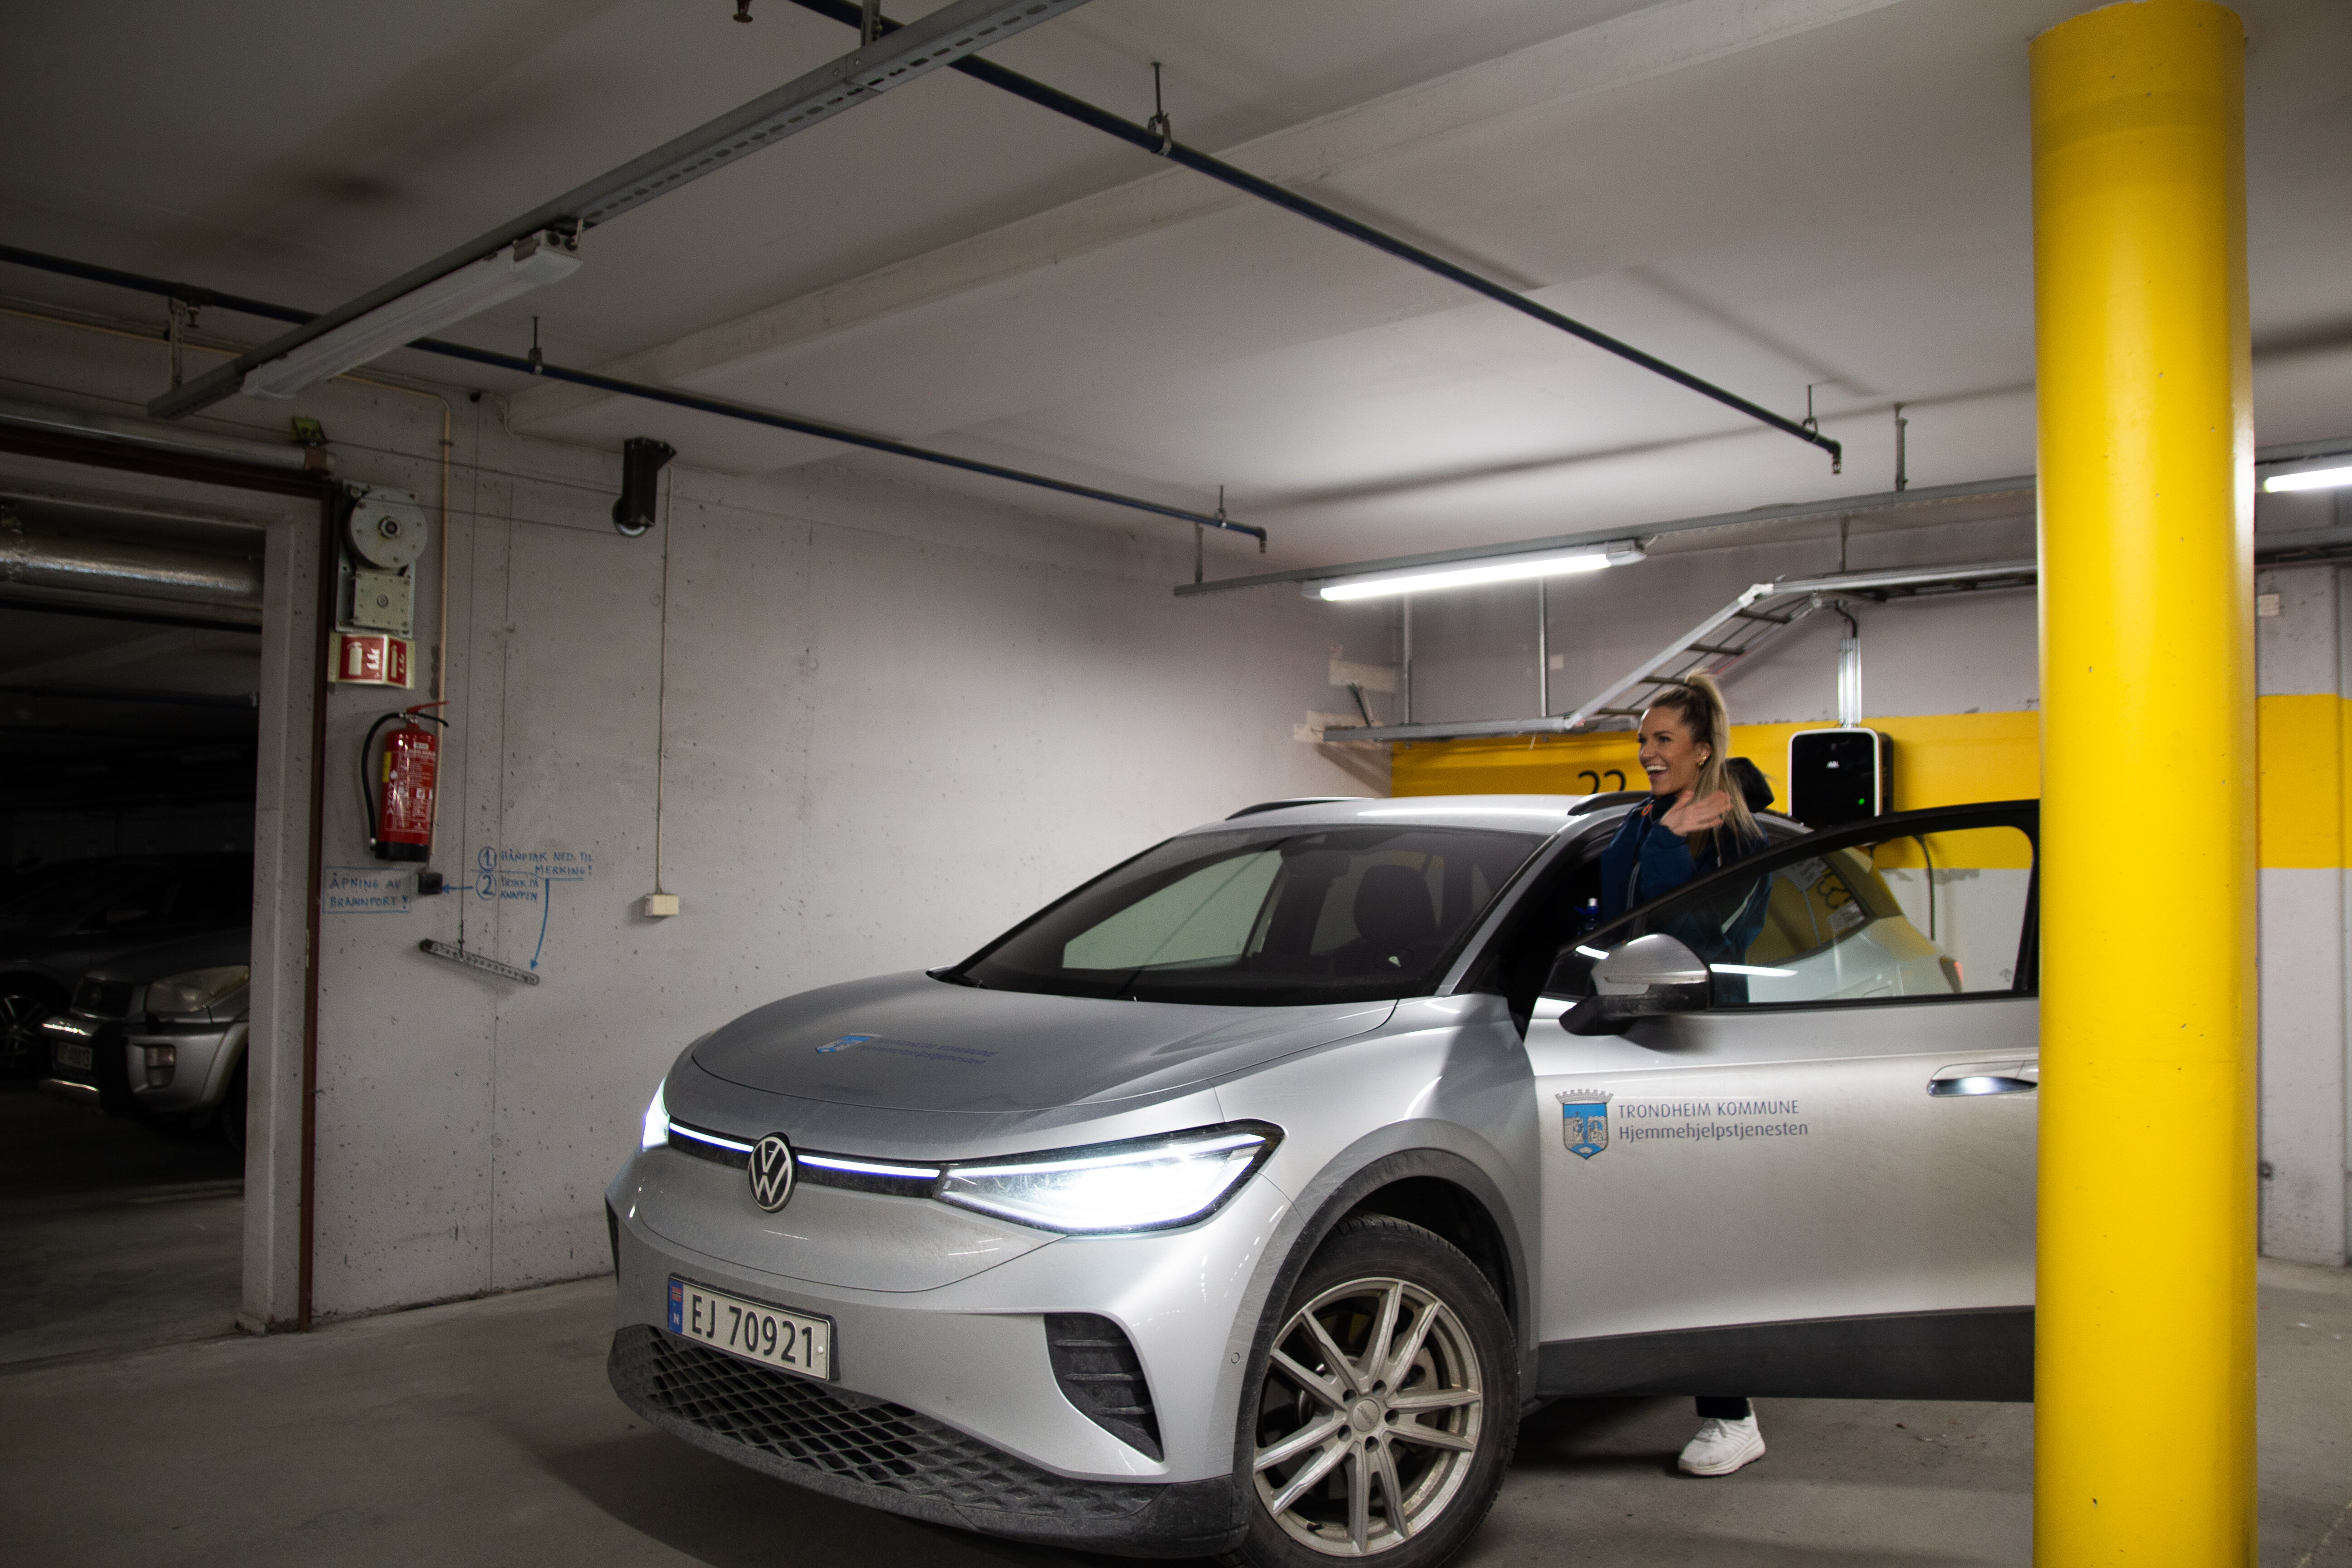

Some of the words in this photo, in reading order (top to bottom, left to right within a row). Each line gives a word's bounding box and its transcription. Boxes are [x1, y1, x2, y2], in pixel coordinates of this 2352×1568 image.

[330, 872, 379, 889] ÅPNING
[1618, 1103, 1711, 1118] TRONDHEIM
[1718, 1100, 1799, 1116] KOMMUNE
[1619, 1122, 1808, 1143] Hjemmehjelpstjenesten
[673, 1313, 680, 1325] N
[692, 1294, 716, 1338] EJ
[729, 1305, 813, 1367] 70921
